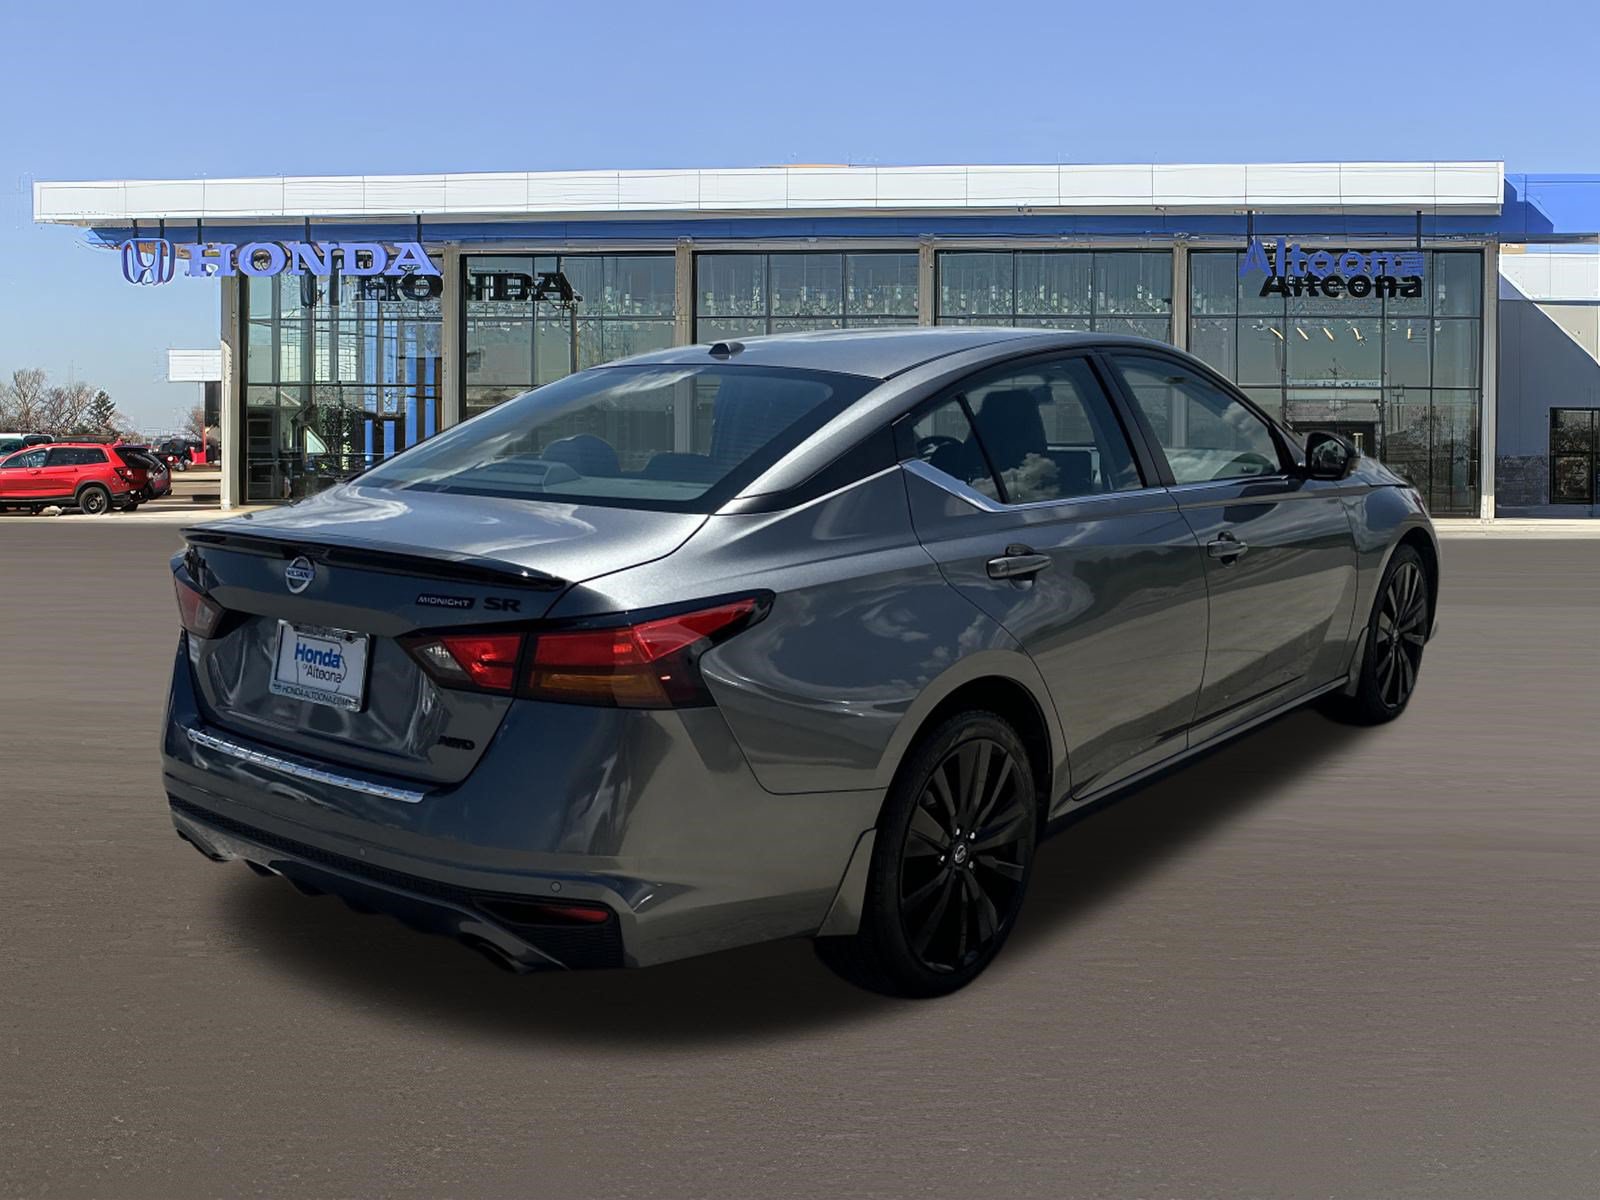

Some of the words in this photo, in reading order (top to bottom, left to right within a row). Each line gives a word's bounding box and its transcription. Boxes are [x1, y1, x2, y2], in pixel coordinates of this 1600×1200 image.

[184, 241, 442, 277] HONDA
[418, 595, 471, 607] MIDNIGHT
[483, 597, 521, 613] SR
[294, 642, 341, 670] Honda
[306, 664, 343, 684] Altoona
